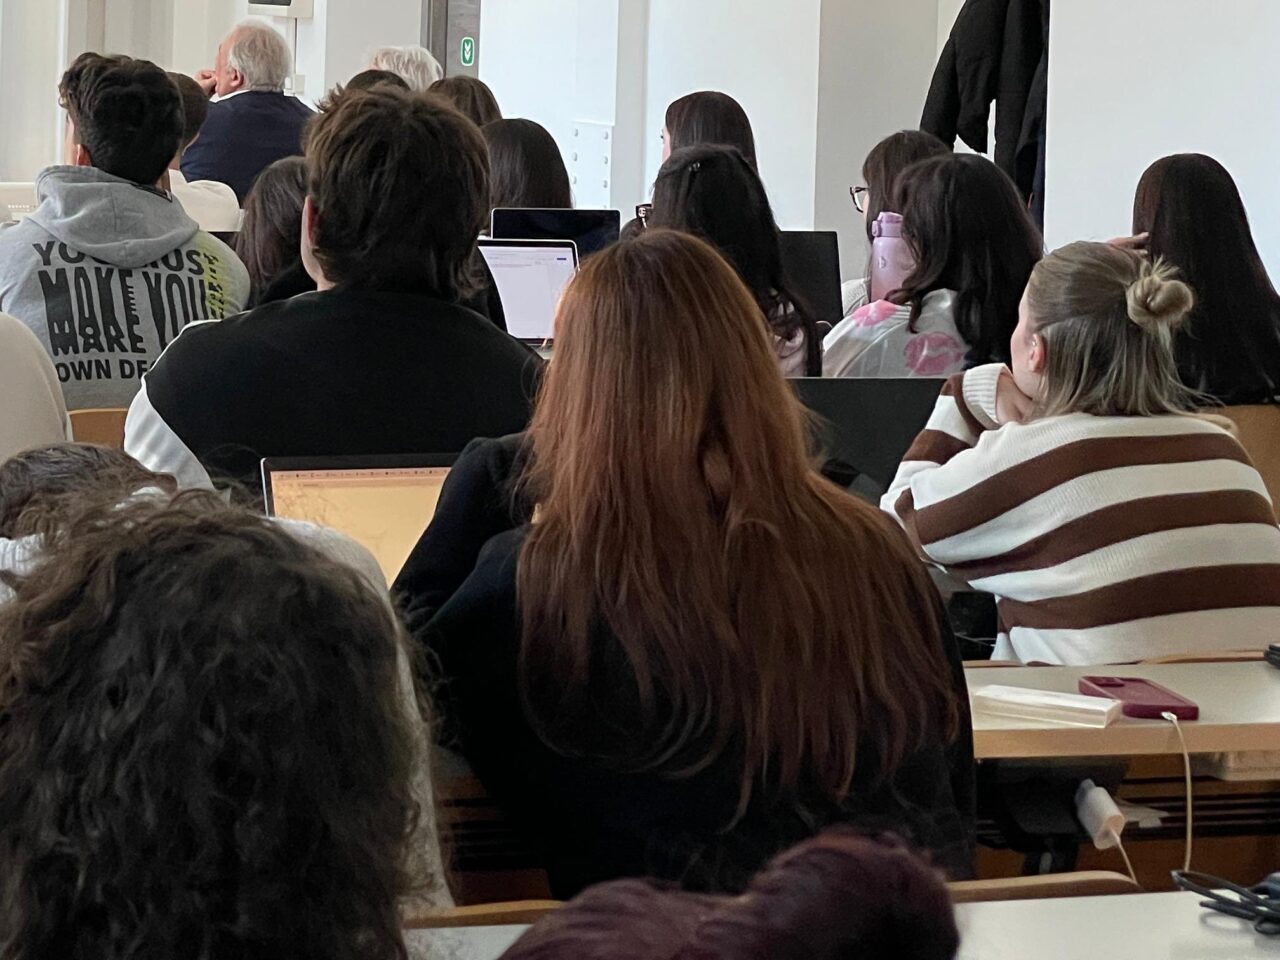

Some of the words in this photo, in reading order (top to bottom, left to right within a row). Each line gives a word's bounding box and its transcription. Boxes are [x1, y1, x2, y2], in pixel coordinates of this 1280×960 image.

[32, 240, 112, 266] YO
[37, 267, 147, 356] MAKE
[55, 359, 112, 382] OWN
